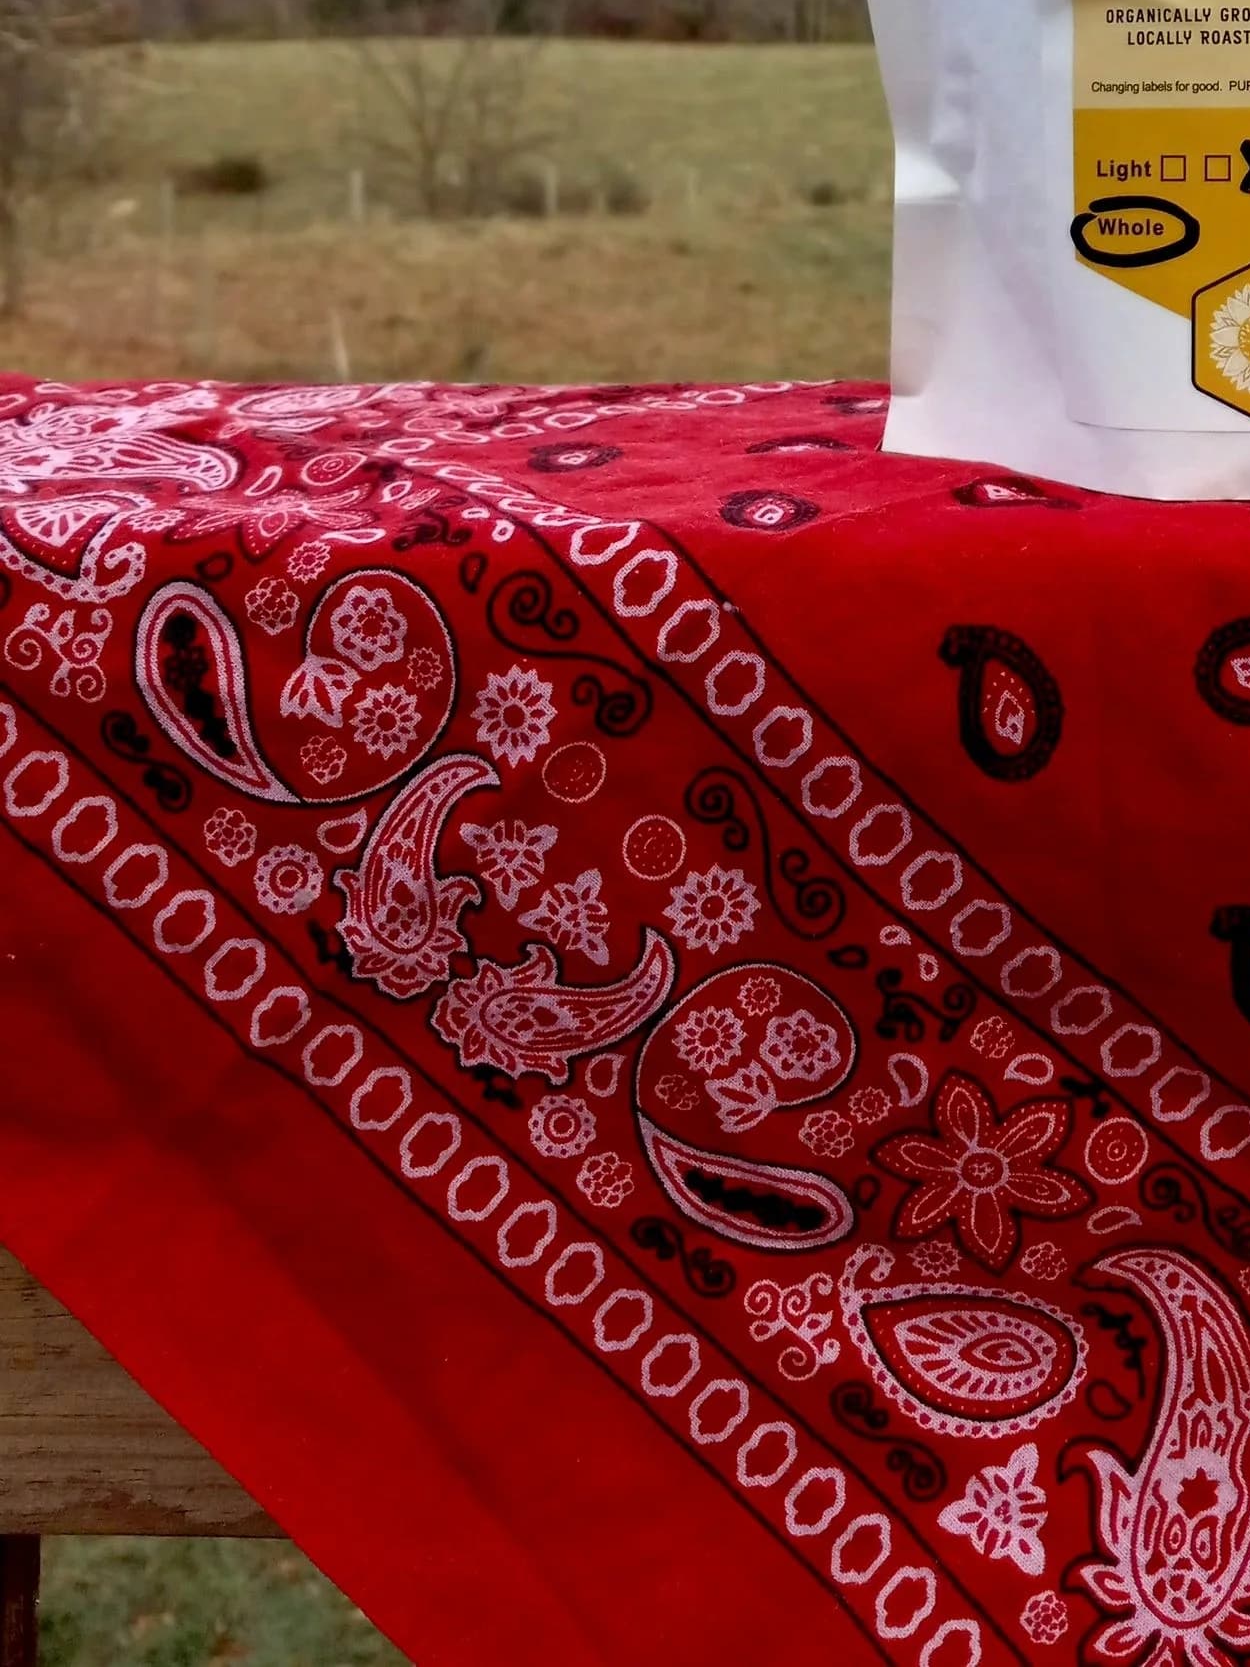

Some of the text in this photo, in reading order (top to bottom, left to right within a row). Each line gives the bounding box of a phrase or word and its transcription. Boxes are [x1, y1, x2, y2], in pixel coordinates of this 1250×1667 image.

[1106, 8, 1212, 24] ORGANICALLY
[1127, 31, 1192, 46] LOCALLY
[1091, 81, 1140, 94] Changing
[1142, 81, 1173, 92] labels
[1175, 81, 1190, 92] for
[1191, 81, 1222, 94] good.
[1096, 159, 1152, 182] Light
[1098, 218, 1165, 236] Whole
